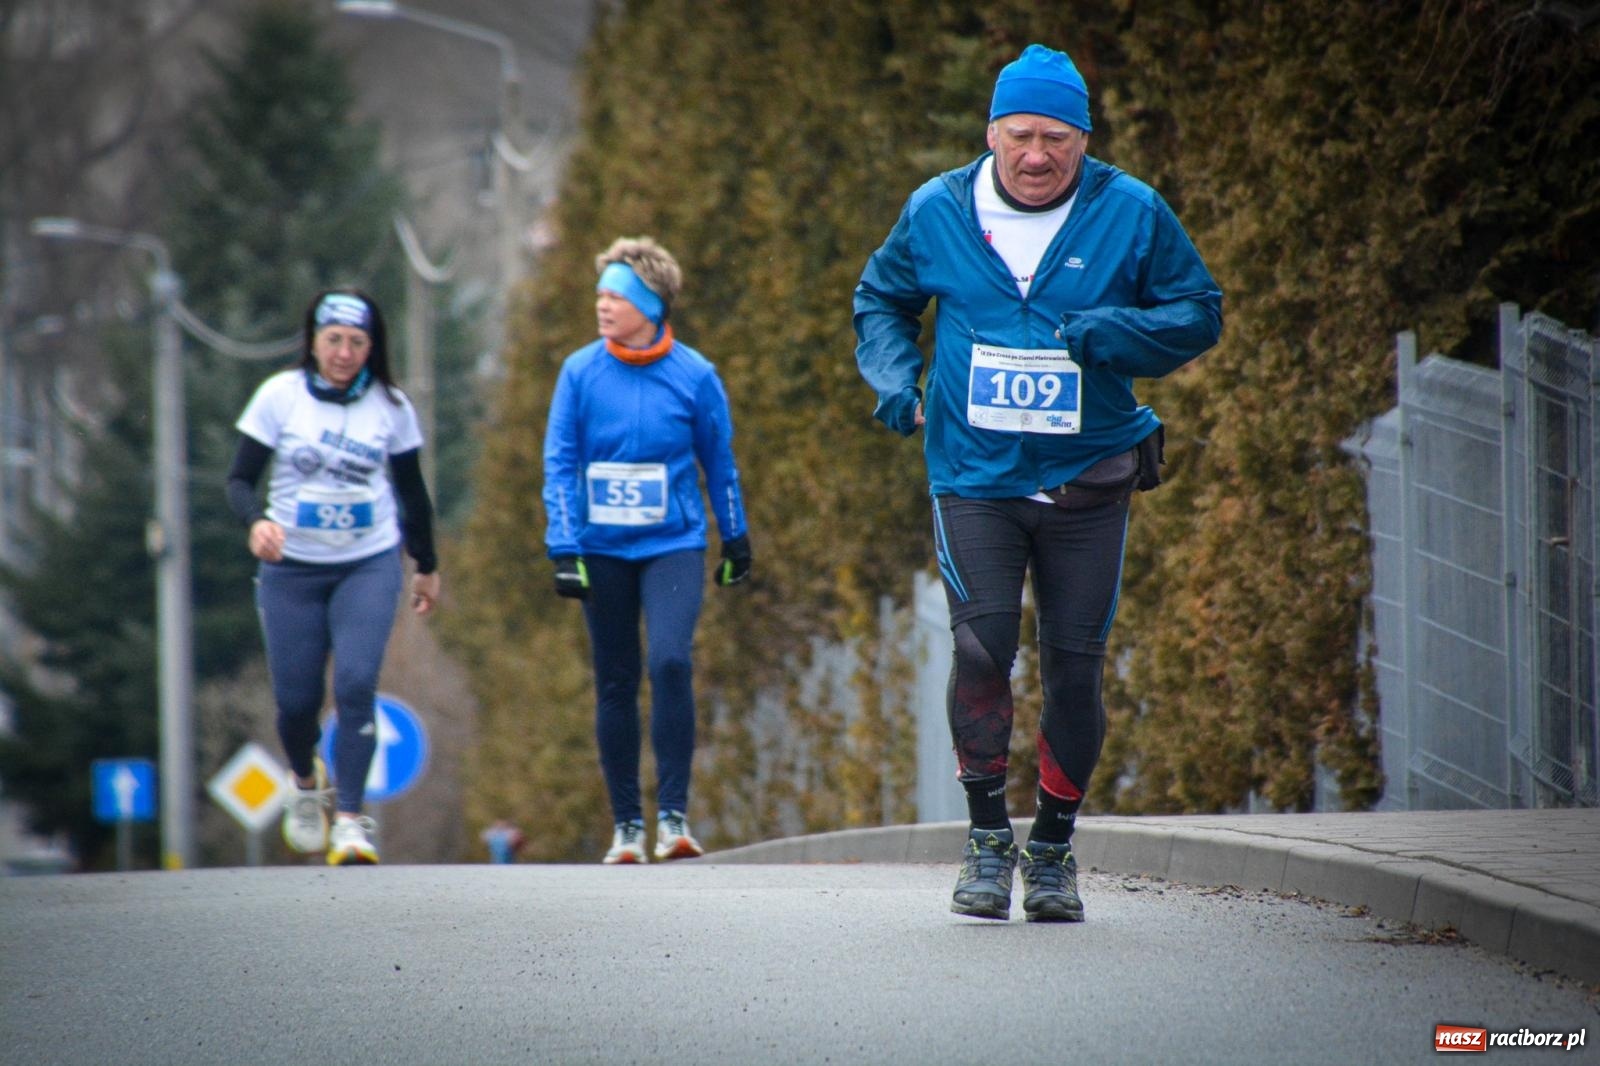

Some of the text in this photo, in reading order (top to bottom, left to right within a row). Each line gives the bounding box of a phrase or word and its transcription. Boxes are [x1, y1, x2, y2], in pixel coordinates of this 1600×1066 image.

[990, 371, 1062, 408] 109
[606, 480, 643, 506] 55
[316, 504, 355, 529] 96
